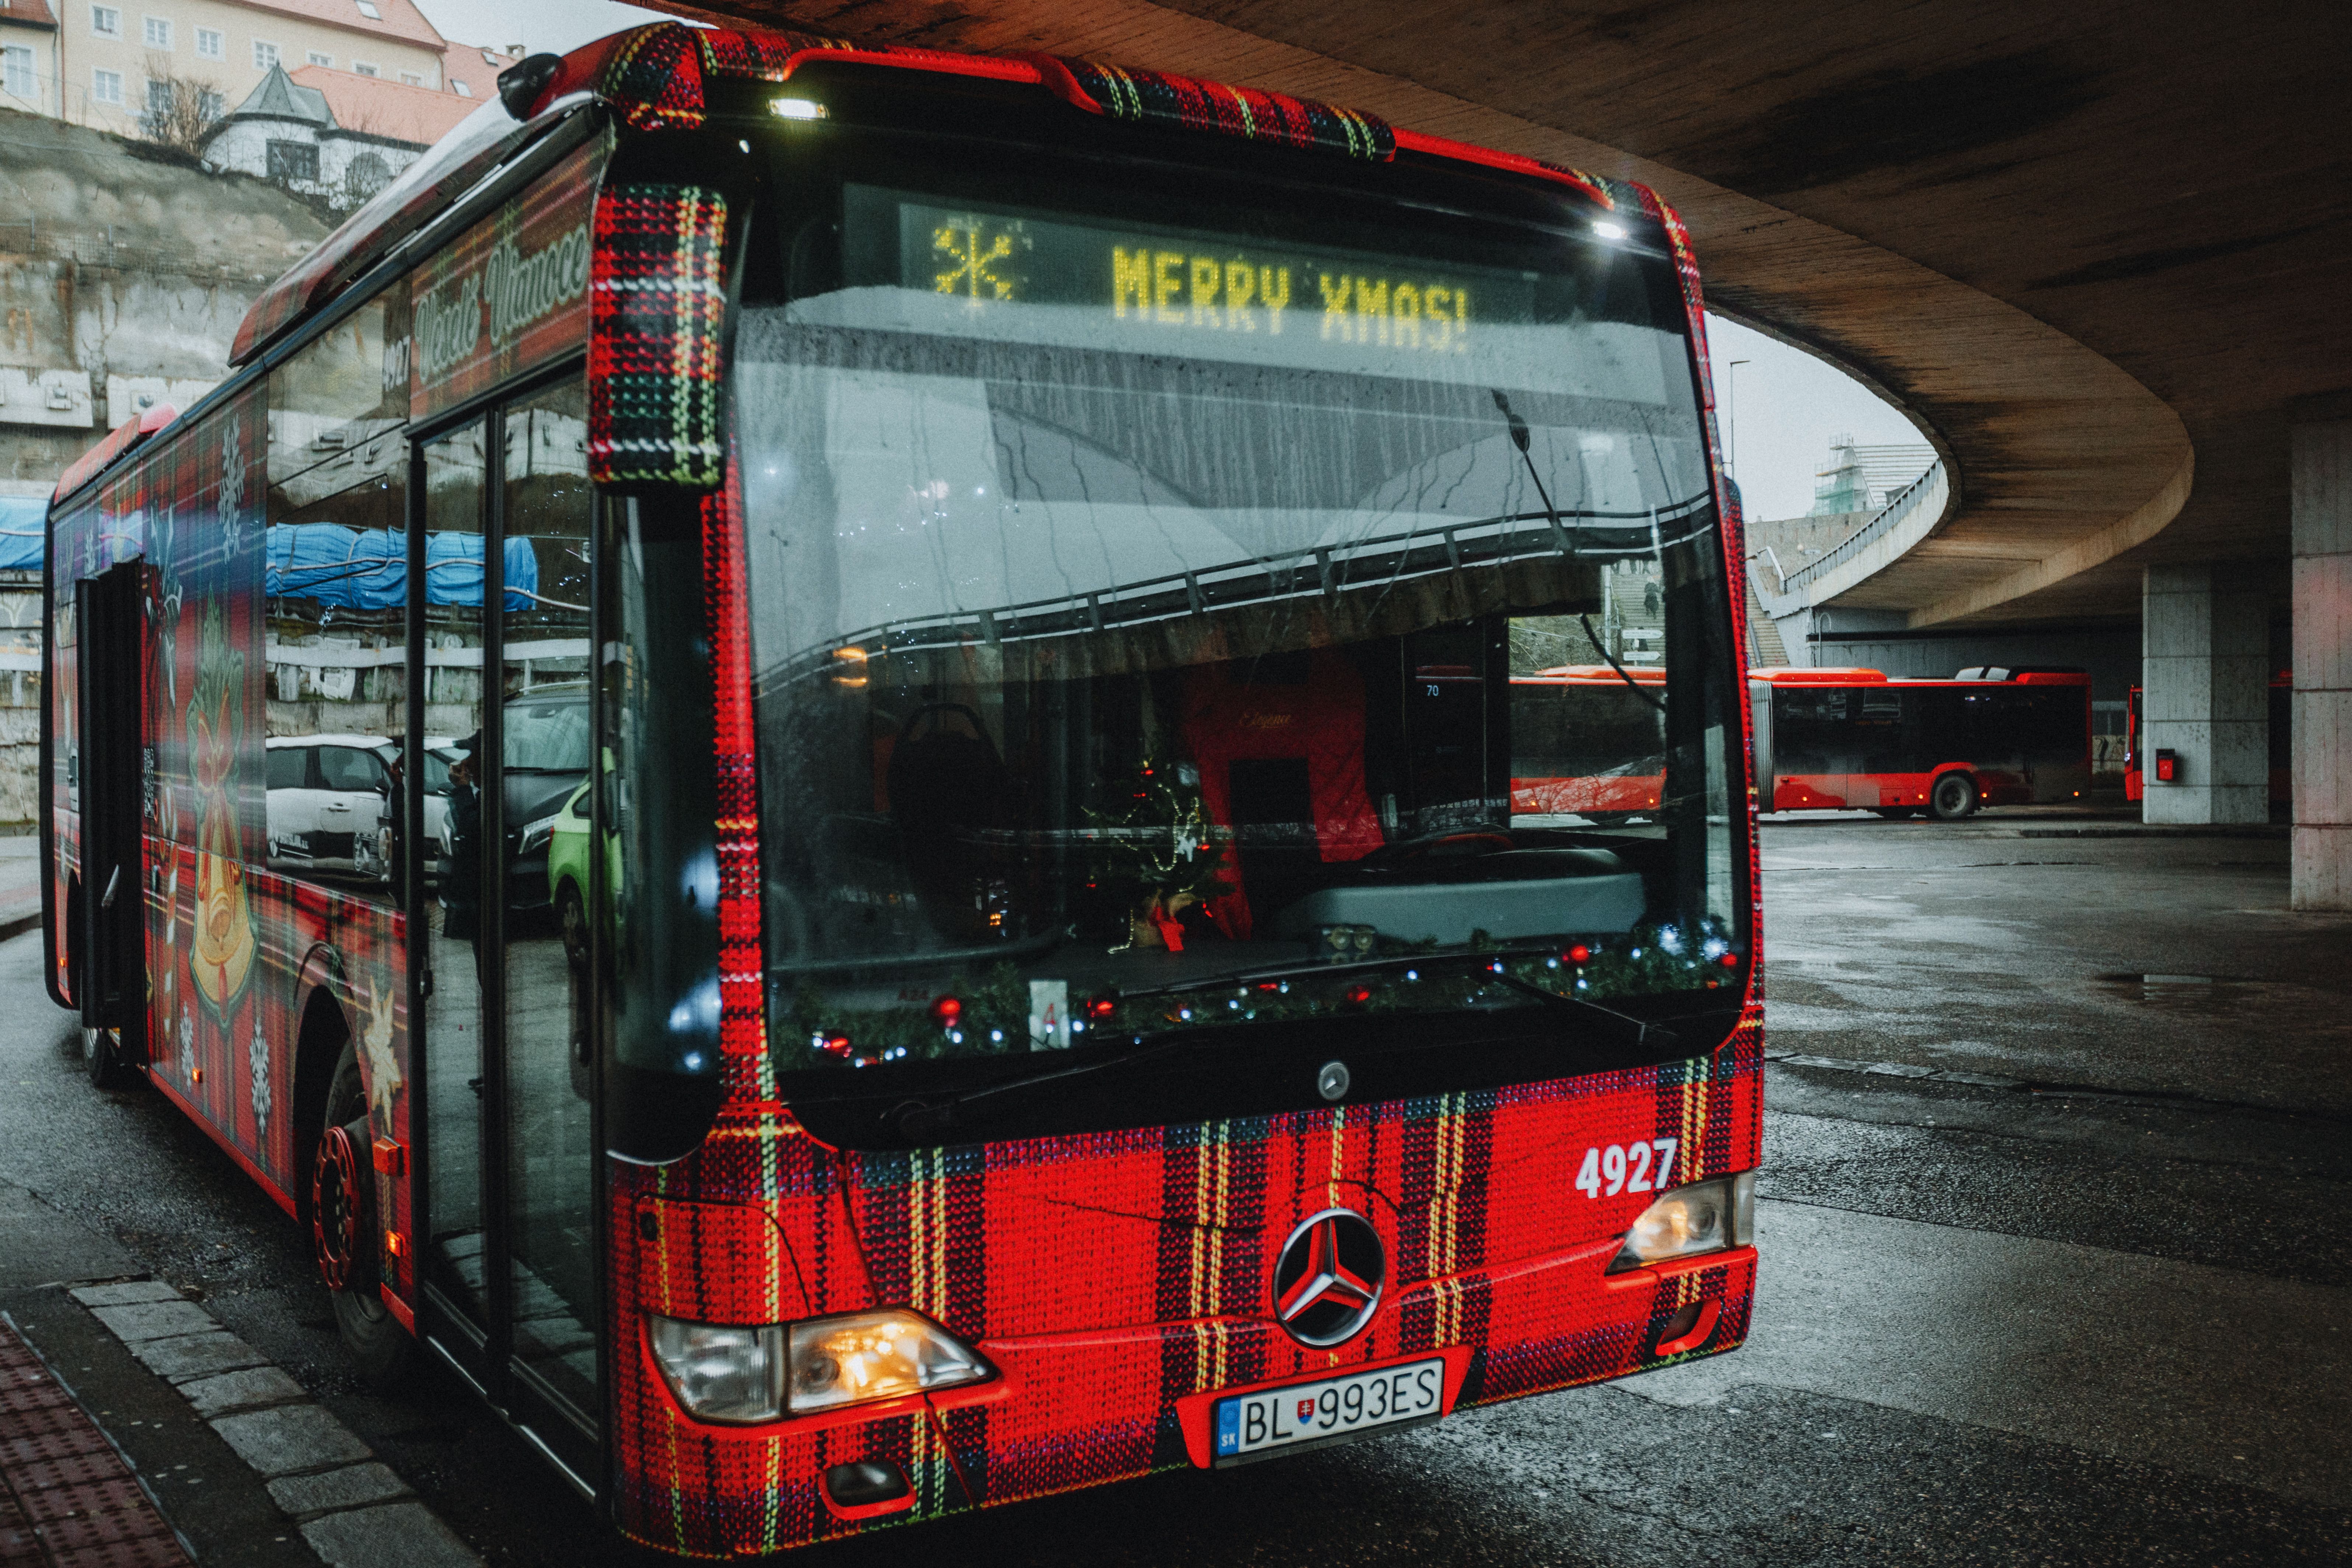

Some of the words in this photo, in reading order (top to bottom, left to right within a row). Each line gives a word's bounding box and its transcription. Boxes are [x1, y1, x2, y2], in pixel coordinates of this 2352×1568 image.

[414, 271, 480, 385] Veselé
[484, 223, 589, 346] Vianoce
[1114, 246, 1289, 335] MERRY
[1320, 273, 1467, 353] XMAS!
[383, 335, 410, 391] 4927
[1427, 685, 1439, 696] 70
[1575, 1137, 1678, 1199] 4927
[1245, 1398, 1293, 1446] BL
[1318, 1369, 1436, 1429] 993ES
[1221, 1433, 1236, 1447] SK
